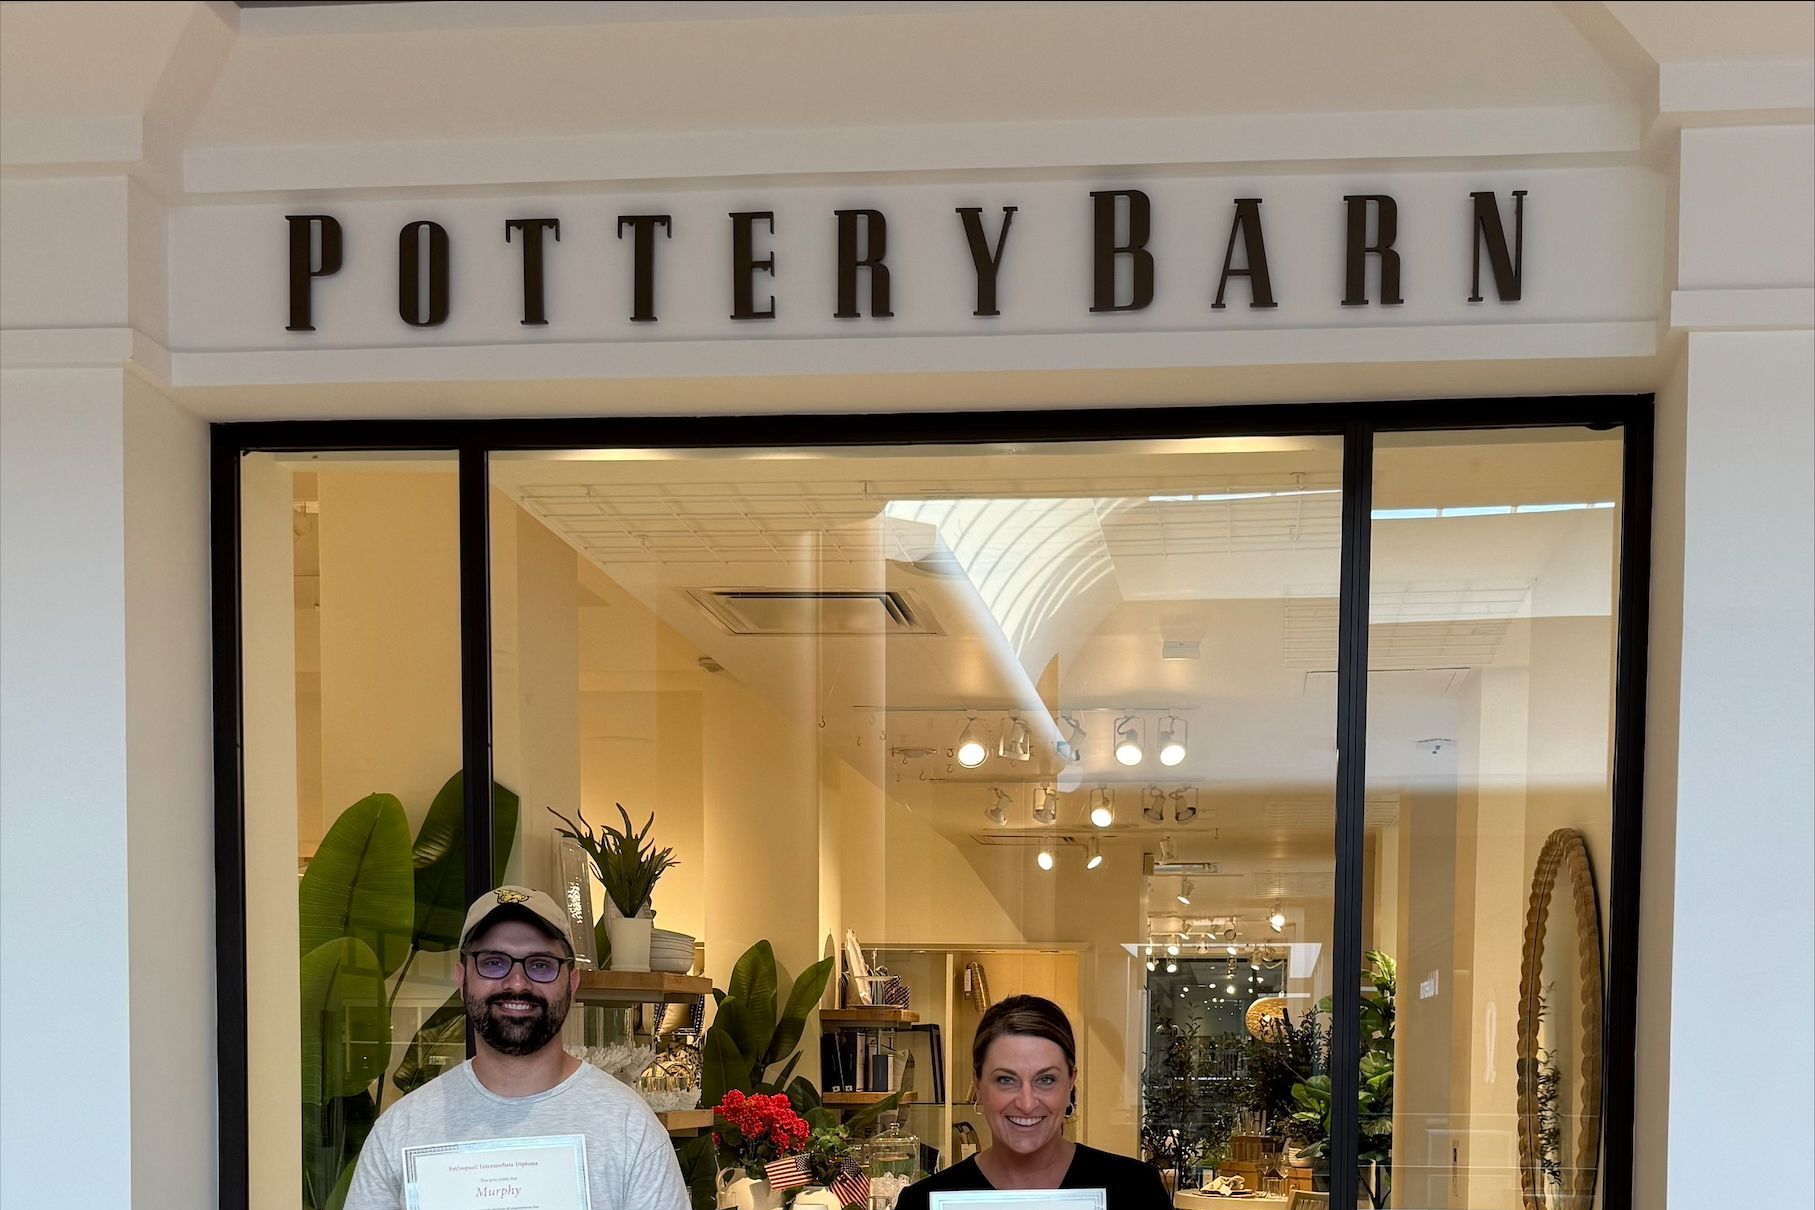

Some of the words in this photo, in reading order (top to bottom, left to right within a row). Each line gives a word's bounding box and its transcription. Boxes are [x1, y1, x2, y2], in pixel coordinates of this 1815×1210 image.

[285, 206, 1018, 332] POTTERY
[1088, 189, 1527, 312] BARN
[475, 1184, 522, 1199] Murphy
